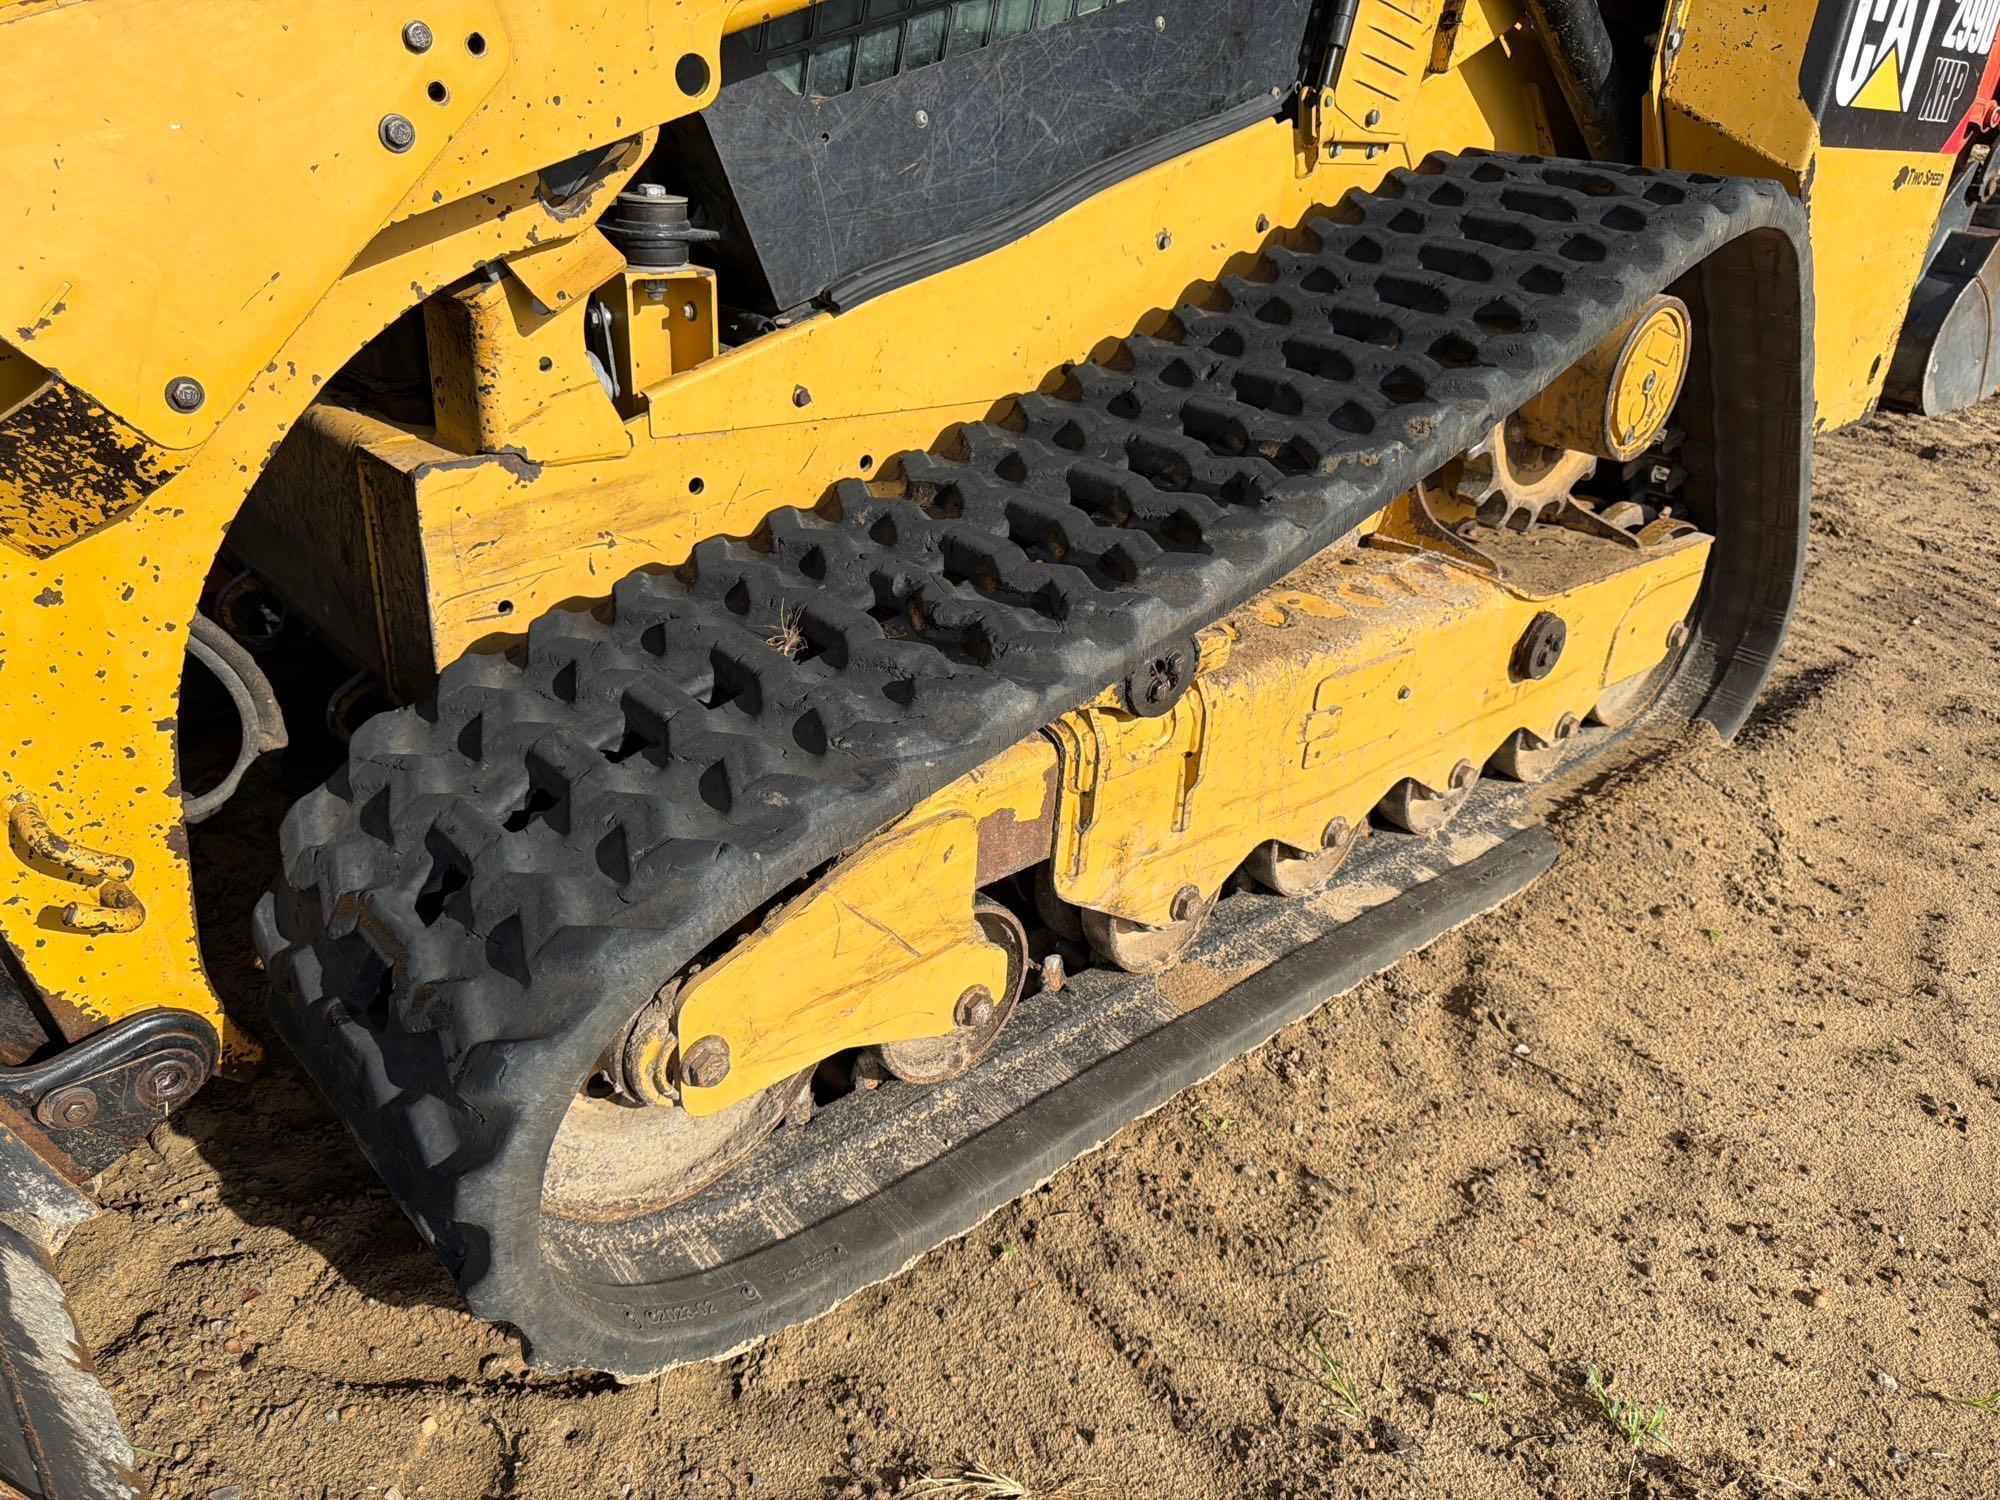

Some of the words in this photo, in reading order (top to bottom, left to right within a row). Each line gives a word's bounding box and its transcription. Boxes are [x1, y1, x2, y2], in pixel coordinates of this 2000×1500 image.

[1835, 0, 1941, 113] CAT
[1941, 0, 2000, 55] 299D
[1917, 56, 1970, 123] XHP
